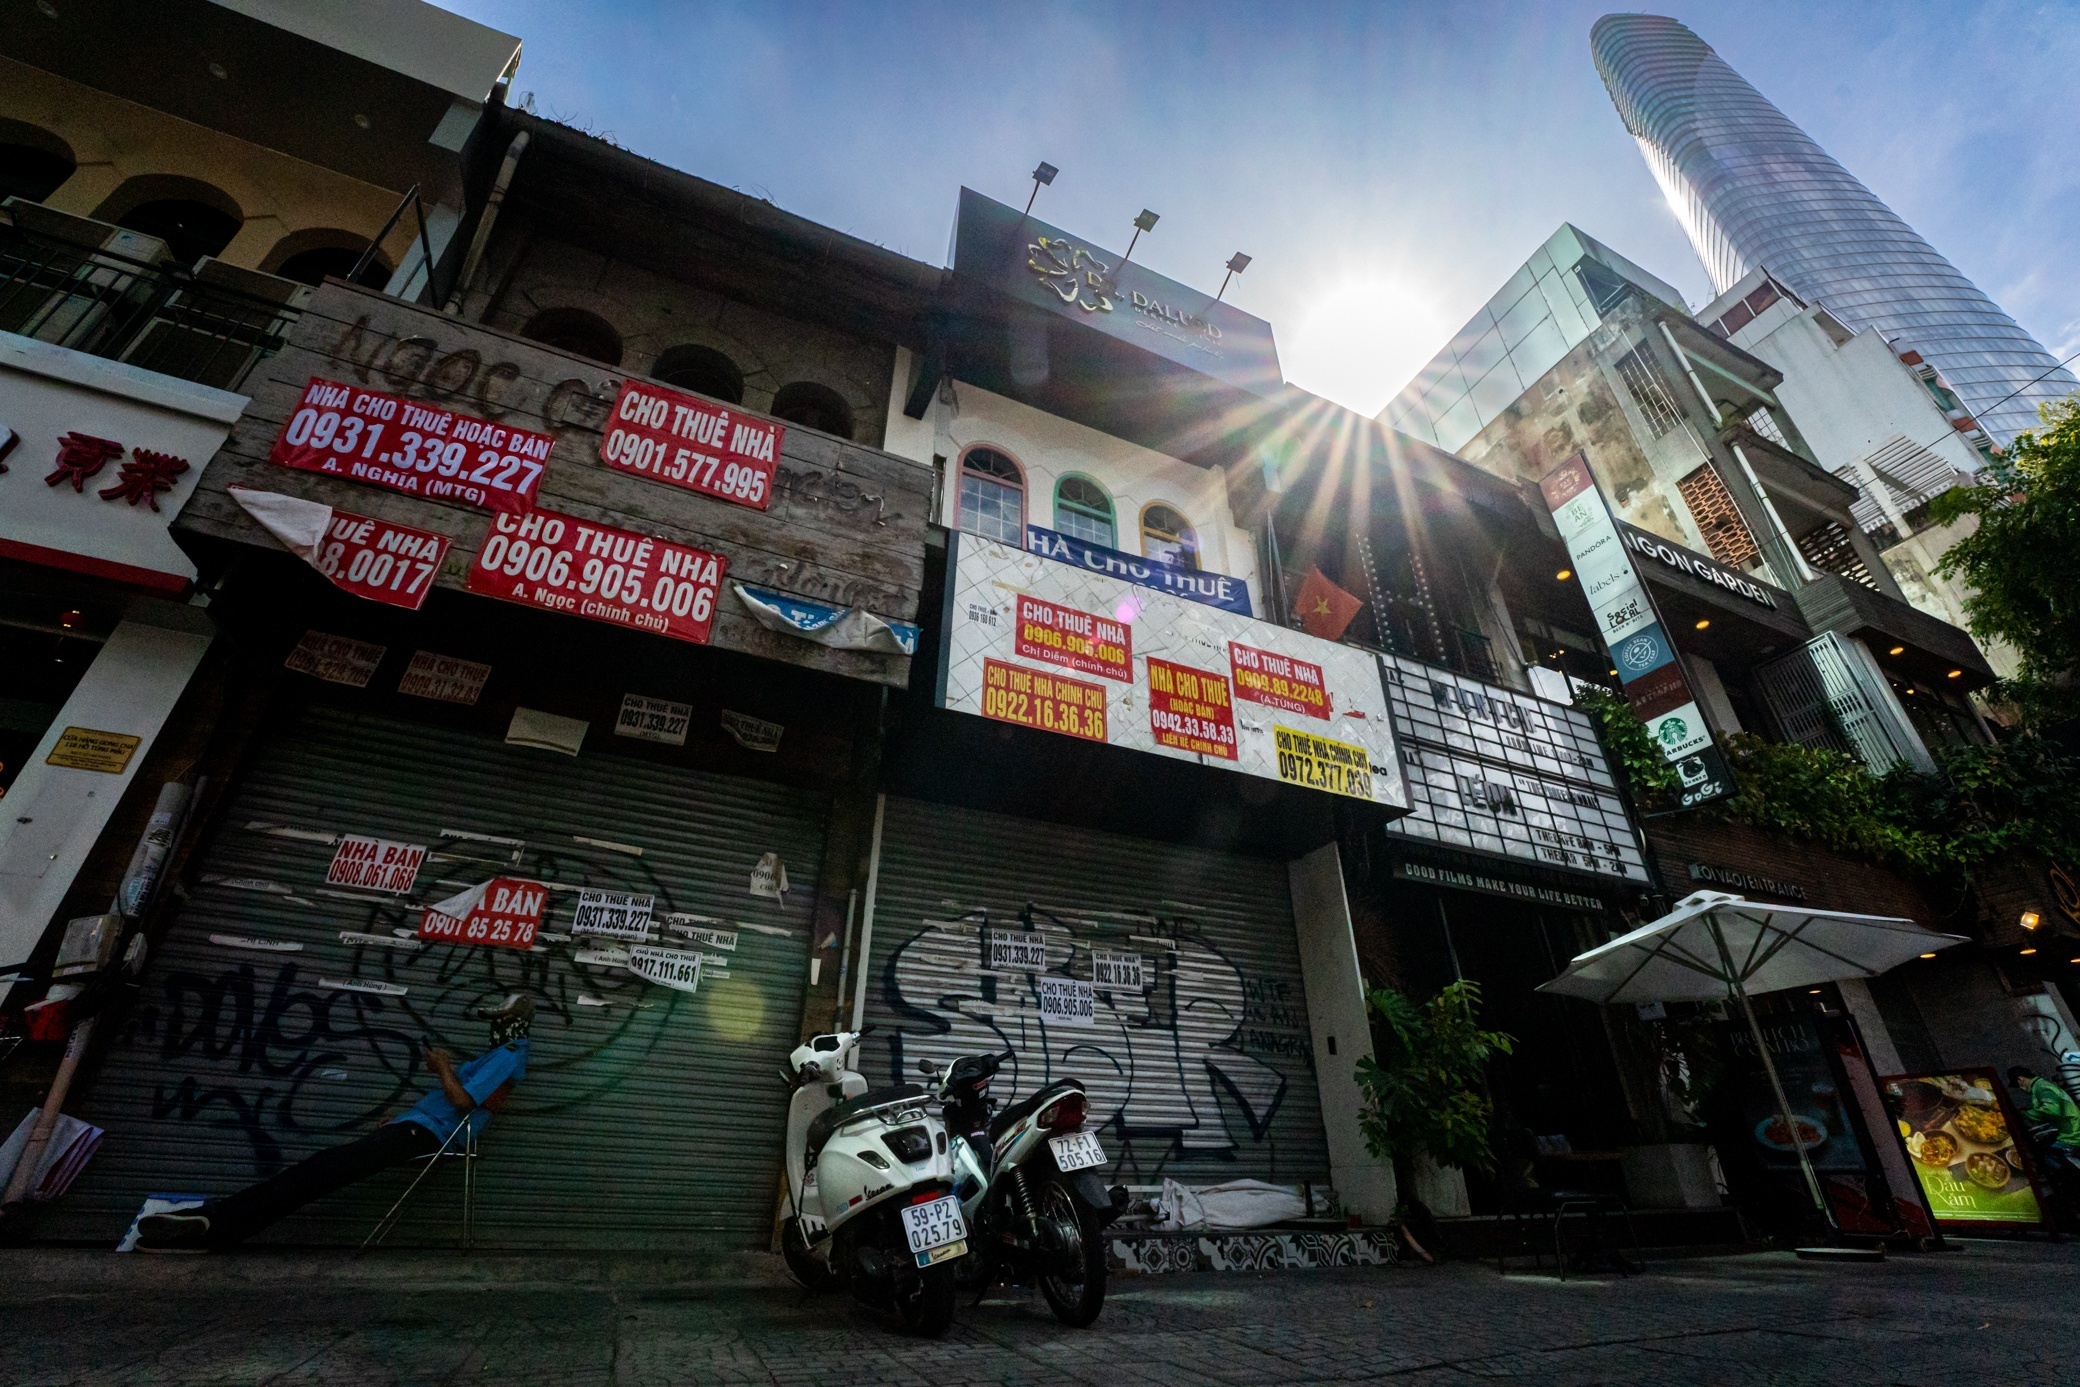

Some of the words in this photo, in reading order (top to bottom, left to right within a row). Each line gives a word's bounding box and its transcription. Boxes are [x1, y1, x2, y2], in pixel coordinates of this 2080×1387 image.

[305, 384, 350, 409] NHÀ
[353, 394, 397, 421] CHO
[400, 405, 452, 437] THUÊ
[452, 421, 505, 449] HOẶC
[507, 433, 550, 460] BÁN
[619, 391, 669, 430] CHO
[672, 405, 730, 453] THUÊ
[730, 424, 775, 463] NHÀ
[285, 408, 543, 495] 0931.339.227
[606, 428, 767, 503] 0901.577.995
[322, 457, 342, 472] A.
[351, 463, 418, 491] NGHĨA
[425, 479, 486, 506] (MTG)
[326, 518, 376, 546] UÊ
[377, 530, 440, 563] NHÀ
[496, 511, 565, 546] CHO
[575, 526, 654, 568] THUÊ
[659, 548, 718, 586] NHÀ
[1027, 531, 1071, 560] HÀ
[1576, 535, 1611, 561] PANDORA
[319, 542, 434, 595] 8.0017
[481, 535, 714, 622] 0906.905.006
[1589, 573, 1620, 595] labels
[1694, 560, 1778, 608] GARDEN
[511, 583, 529, 599] A.
[534, 588, 575, 609] Ngọc
[580, 598, 631, 623] (chính
[635, 613, 670, 634] chủ)
[1023, 601, 1053, 625] CHO
[1056, 607, 1092, 635] THUÊ
[1096, 618, 1126, 646] NHÀ
[1607, 599, 1637, 621] Social
[1024, 623, 1126, 665] 0906.905.006
[1022, 643, 1040, 659] Chị
[1043, 646, 1069, 664] Diễm
[1072, 656, 1103, 676] (chính
[1105, 664, 1128, 680] chủ)
[1233, 647, 1259, 670] CHO
[1261, 654, 1292, 679] THUÊ
[1294, 664, 1319, 686] NHÀ
[987, 665, 1006, 687] CHO
[1009, 669, 1032, 694] THUÊ
[1034, 675, 1053, 699] NHÀ
[1055, 681, 1083, 704] CHÍNH
[1085, 687, 1103, 710] CHỦ
[1150, 663, 1174, 694] NHÀ
[1176, 674, 1198, 700] CHO
[1201, 675, 1229, 707] THUÊ
[1236, 668, 1324, 707] 0909.89.2248
[620, 709, 686, 735] 0931.339.227
[624, 697, 643, 708] CHO
[646, 699, 669, 712] THUÊ
[671, 703, 689, 717] NHÀ
[986, 687, 1104, 740] 0922.16.36.36
[1152, 709, 1234, 745] 0942.33.58.33
[1276, 730, 1293, 752] CHO
[1293, 731, 1312, 756] THUÊ
[1312, 737, 1330, 759] NHÀ
[1665, 737, 1704, 757] ARBUCKS
[1457, 773, 1518, 817] LÉON
[338, 839, 379, 862] NHÀ
[383, 843, 421, 868] BÁN
[329, 859, 416, 892] 0908.061.068
[1405, 863, 1436, 880] GOOD
[1438, 869, 1473, 887] FILMS
[1476, 877, 1506, 892] MAKE
[1508, 882, 1536, 898] YOUR
[1538, 887, 1562, 903] LIFE
[1564, 892, 1603, 910] BETTER
[492, 884, 545, 917] BÁN
[582, 892, 601, 903] CHO
[604, 893, 628, 907] THUÊ
[631, 895, 651, 909] NHÀ
[423, 912, 463, 937] 0901
[467, 916, 489, 938] 85
[490, 919, 511, 941] 25
[514, 921, 535, 943] 78
[577, 905, 650, 933] 0931.339.227
[667, 915, 685, 926] CHO
[691, 927, 715, 945] THUÊ
[715, 932, 736, 947] NHÀ
[993, 932, 1007, 941] CHO
[1010, 933, 1027, 944] THUÊ
[1029, 935, 1044, 945] NHÀ
[665, 952, 679, 960] CHO
[680, 952, 697, 963] THUÊ
[993, 943, 1045, 967] 0931.339.227
[1095, 953, 1107, 961] CHO
[1109, 954, 1123, 963] THUÊ
[631, 956, 697, 985] 0917.111.661
[1096, 962, 1141, 986] 0922.16.36.36
[1042, 981, 1057, 996] CHO
[1058, 980, 1077, 998] THUÊ
[1078, 982, 1093, 999] NHÀ
[1043, 996, 1093, 1018] 0906.905.006
[1057, 1135, 1092, 1154] 72-F1
[1059, 1149, 1103, 1170] 505.16
[864, 1183, 894, 1201] Vespa
[911, 1201, 953, 1228] 59-P2
[911, 1219, 962, 1249] 025.79
